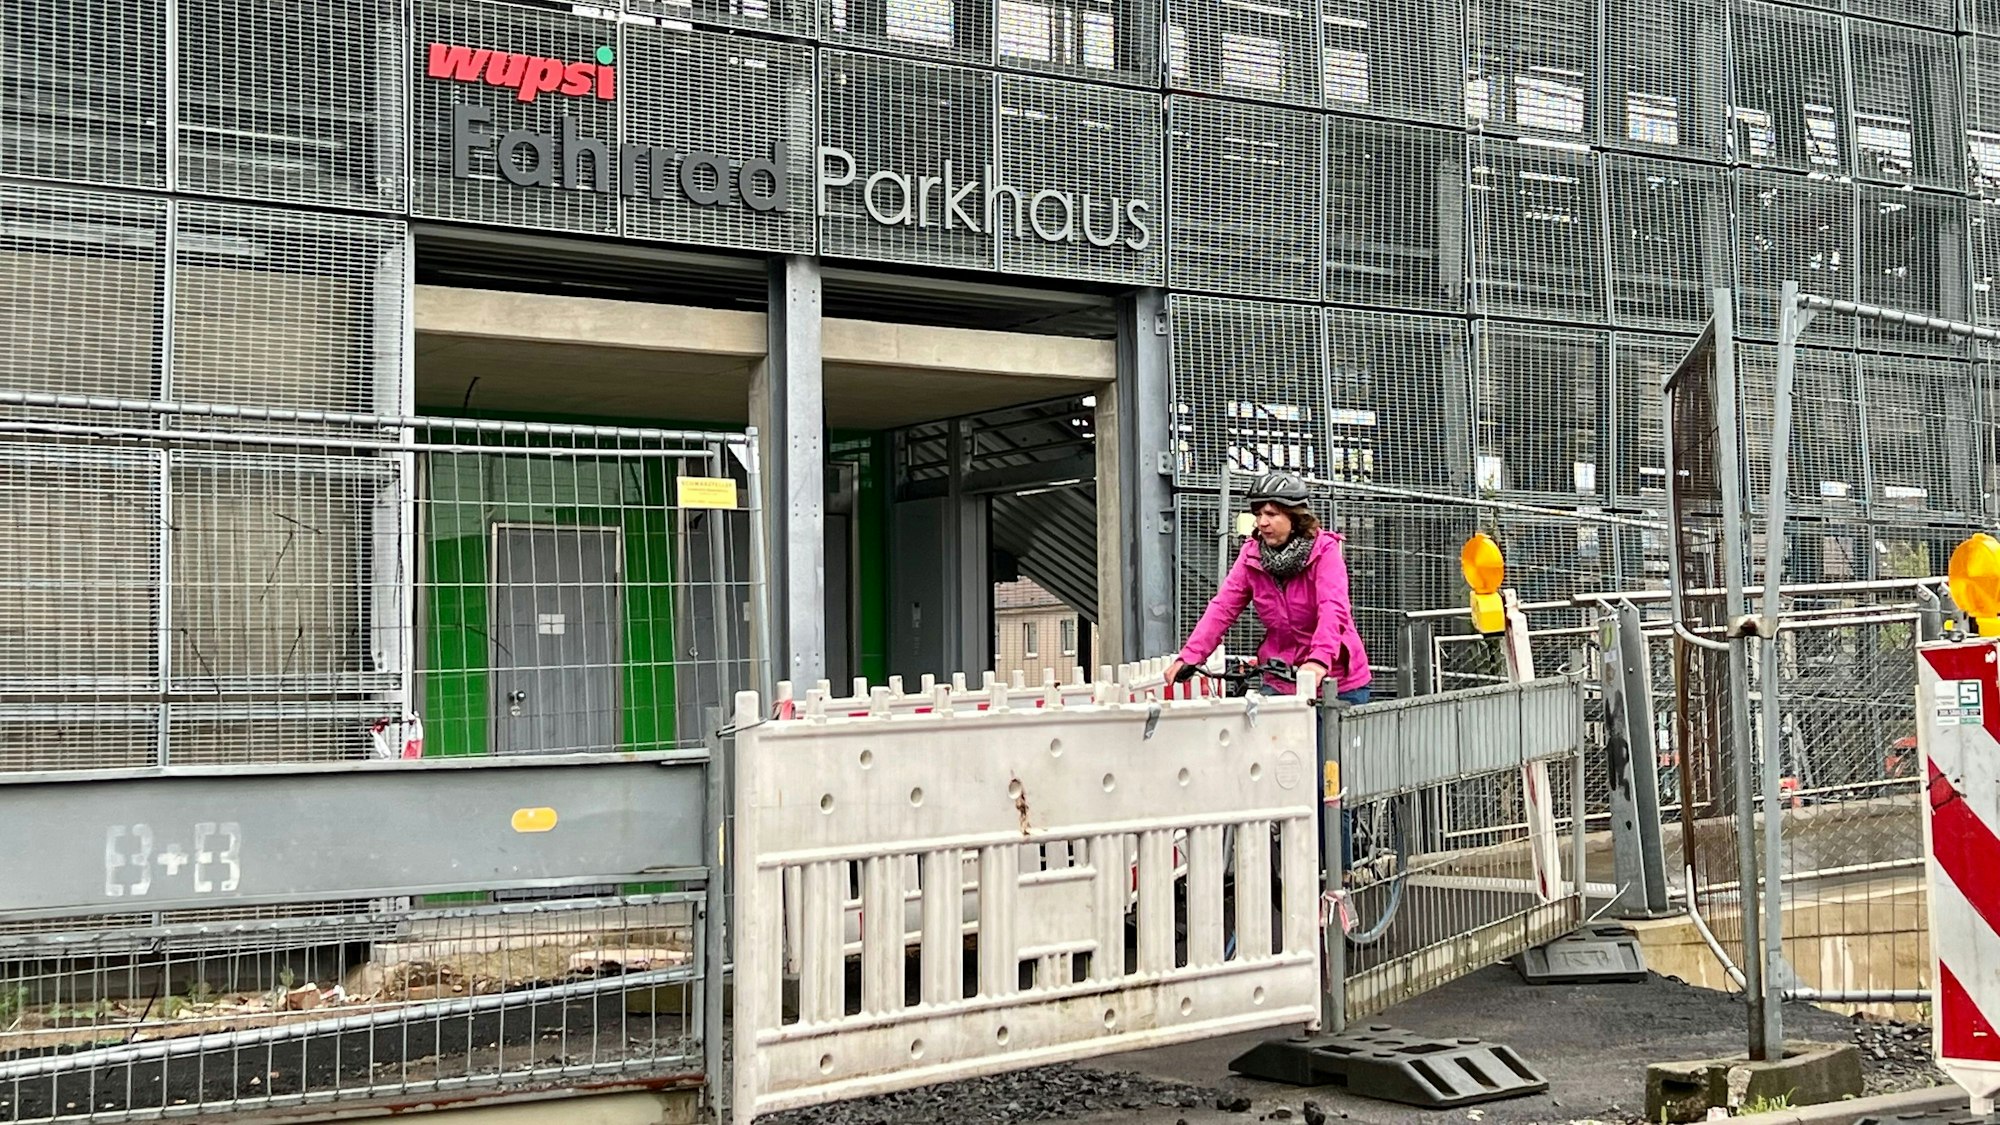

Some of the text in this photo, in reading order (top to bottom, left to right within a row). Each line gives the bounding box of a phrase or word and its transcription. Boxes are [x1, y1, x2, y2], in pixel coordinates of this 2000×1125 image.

[428, 43, 614, 103] wupsi
[454, 104, 1150, 250] Fahrrad Parkhaus
